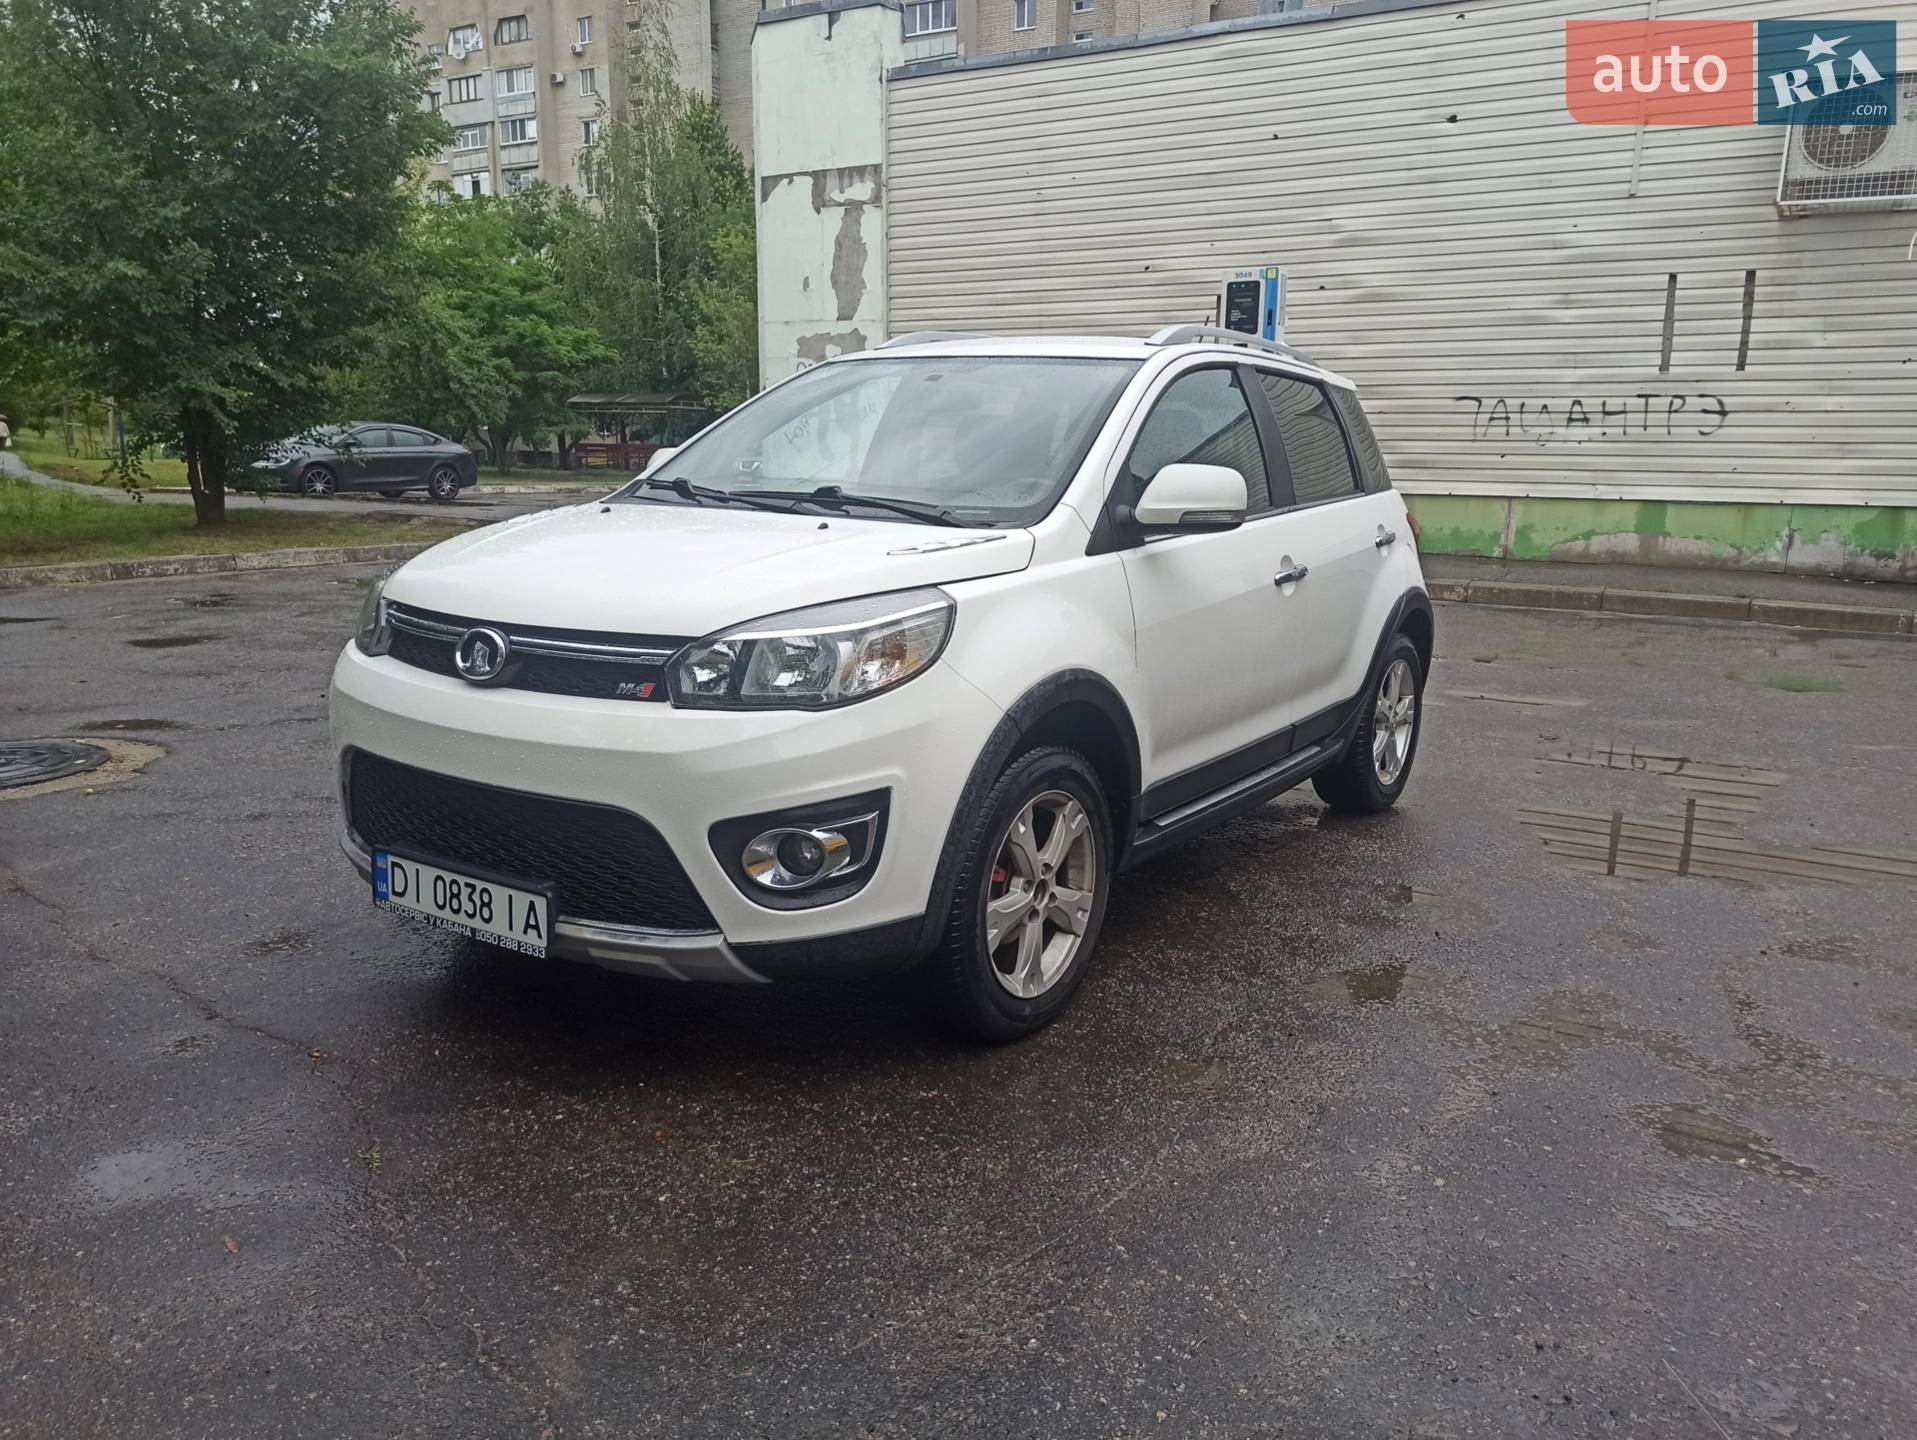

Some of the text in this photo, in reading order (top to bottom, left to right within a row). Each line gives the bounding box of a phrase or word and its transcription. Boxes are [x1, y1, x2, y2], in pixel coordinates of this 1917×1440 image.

[1234, 271, 1253, 279] 3049
[376, 880, 388, 894] UA
[390, 860, 543, 940] DI 0838 IA
[380, 899, 546, 959] АВТОСЕРВІС У КАБАНА 050 288 2933
